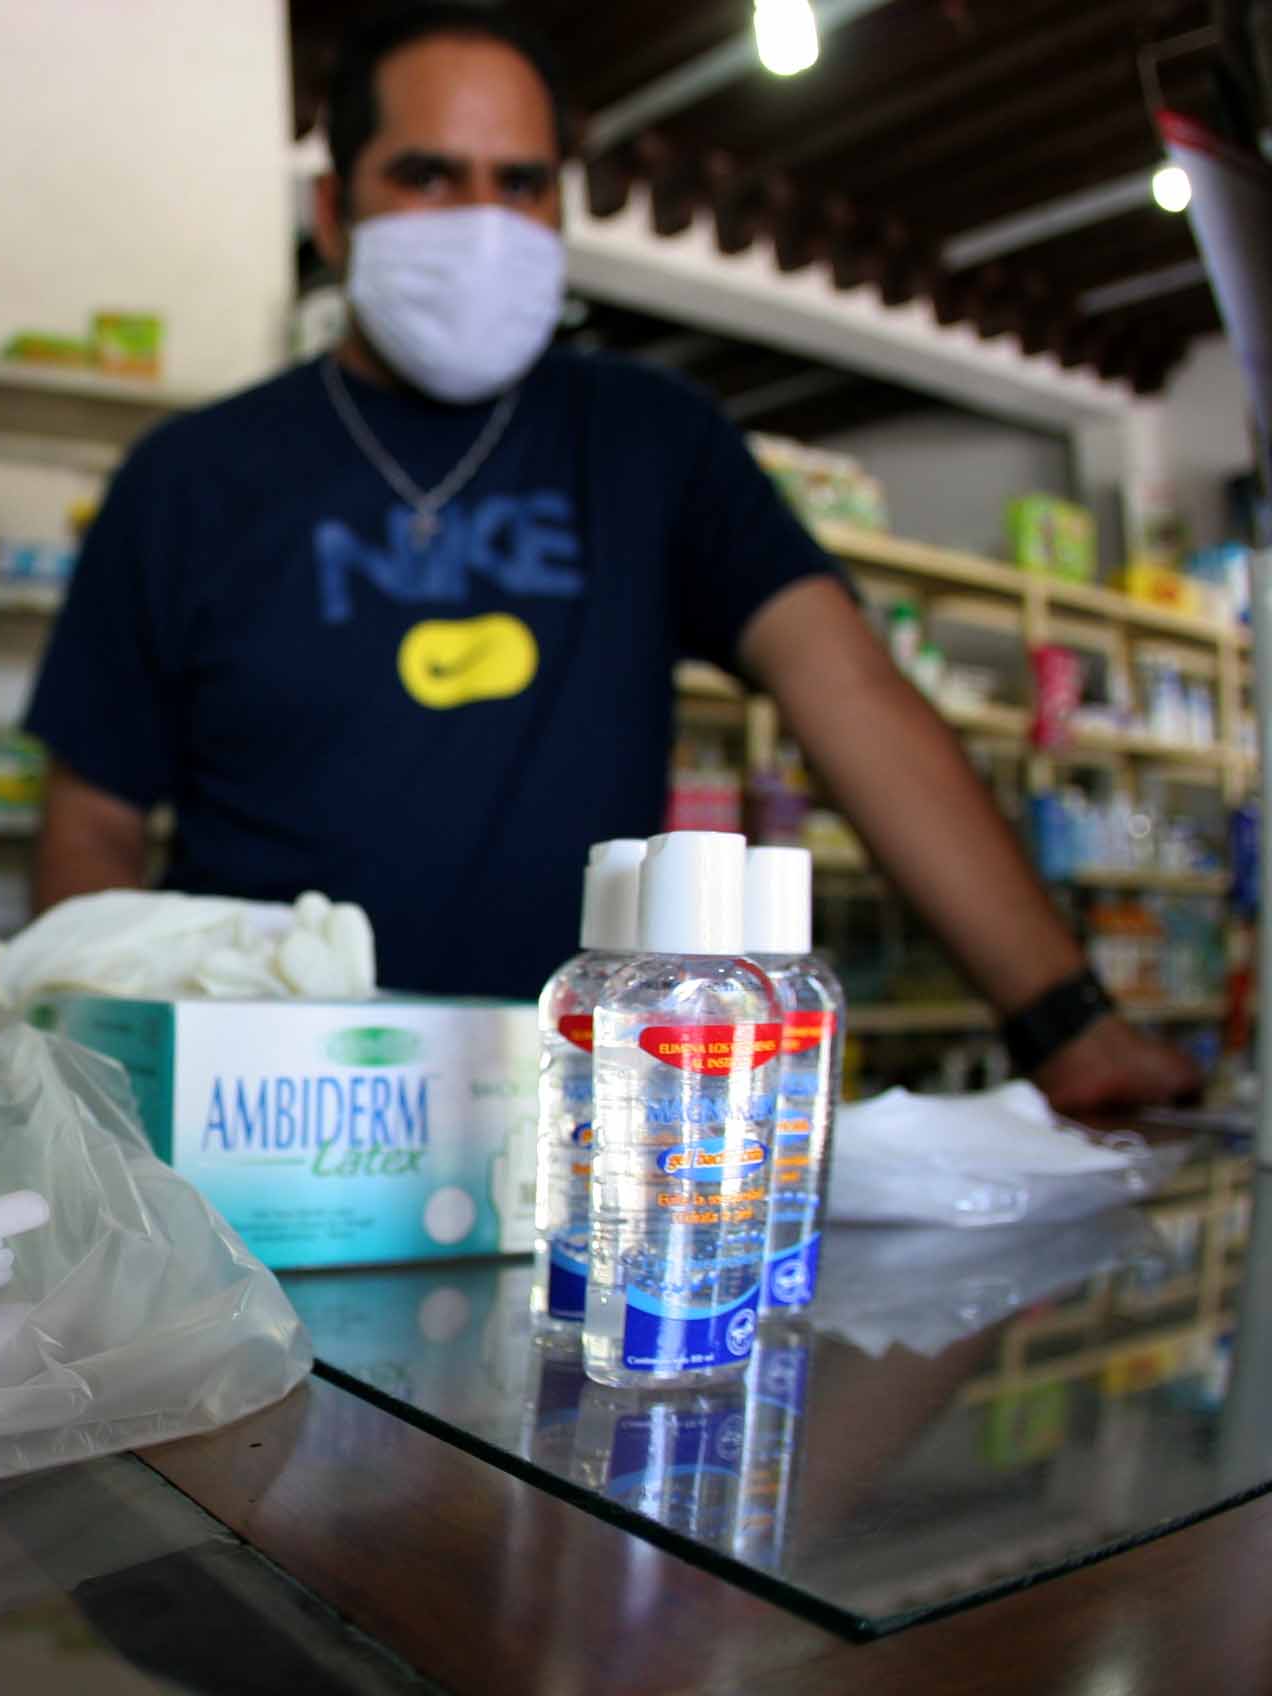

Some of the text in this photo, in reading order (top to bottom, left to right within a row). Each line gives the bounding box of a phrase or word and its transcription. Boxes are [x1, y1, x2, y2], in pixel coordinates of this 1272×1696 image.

[314, 492, 583, 624] NIKE
[659, 1042, 705, 1055] ELIMINA
[202, 1072, 431, 1151] AMBIDERM
[310, 1138, 425, 1177] Latex
